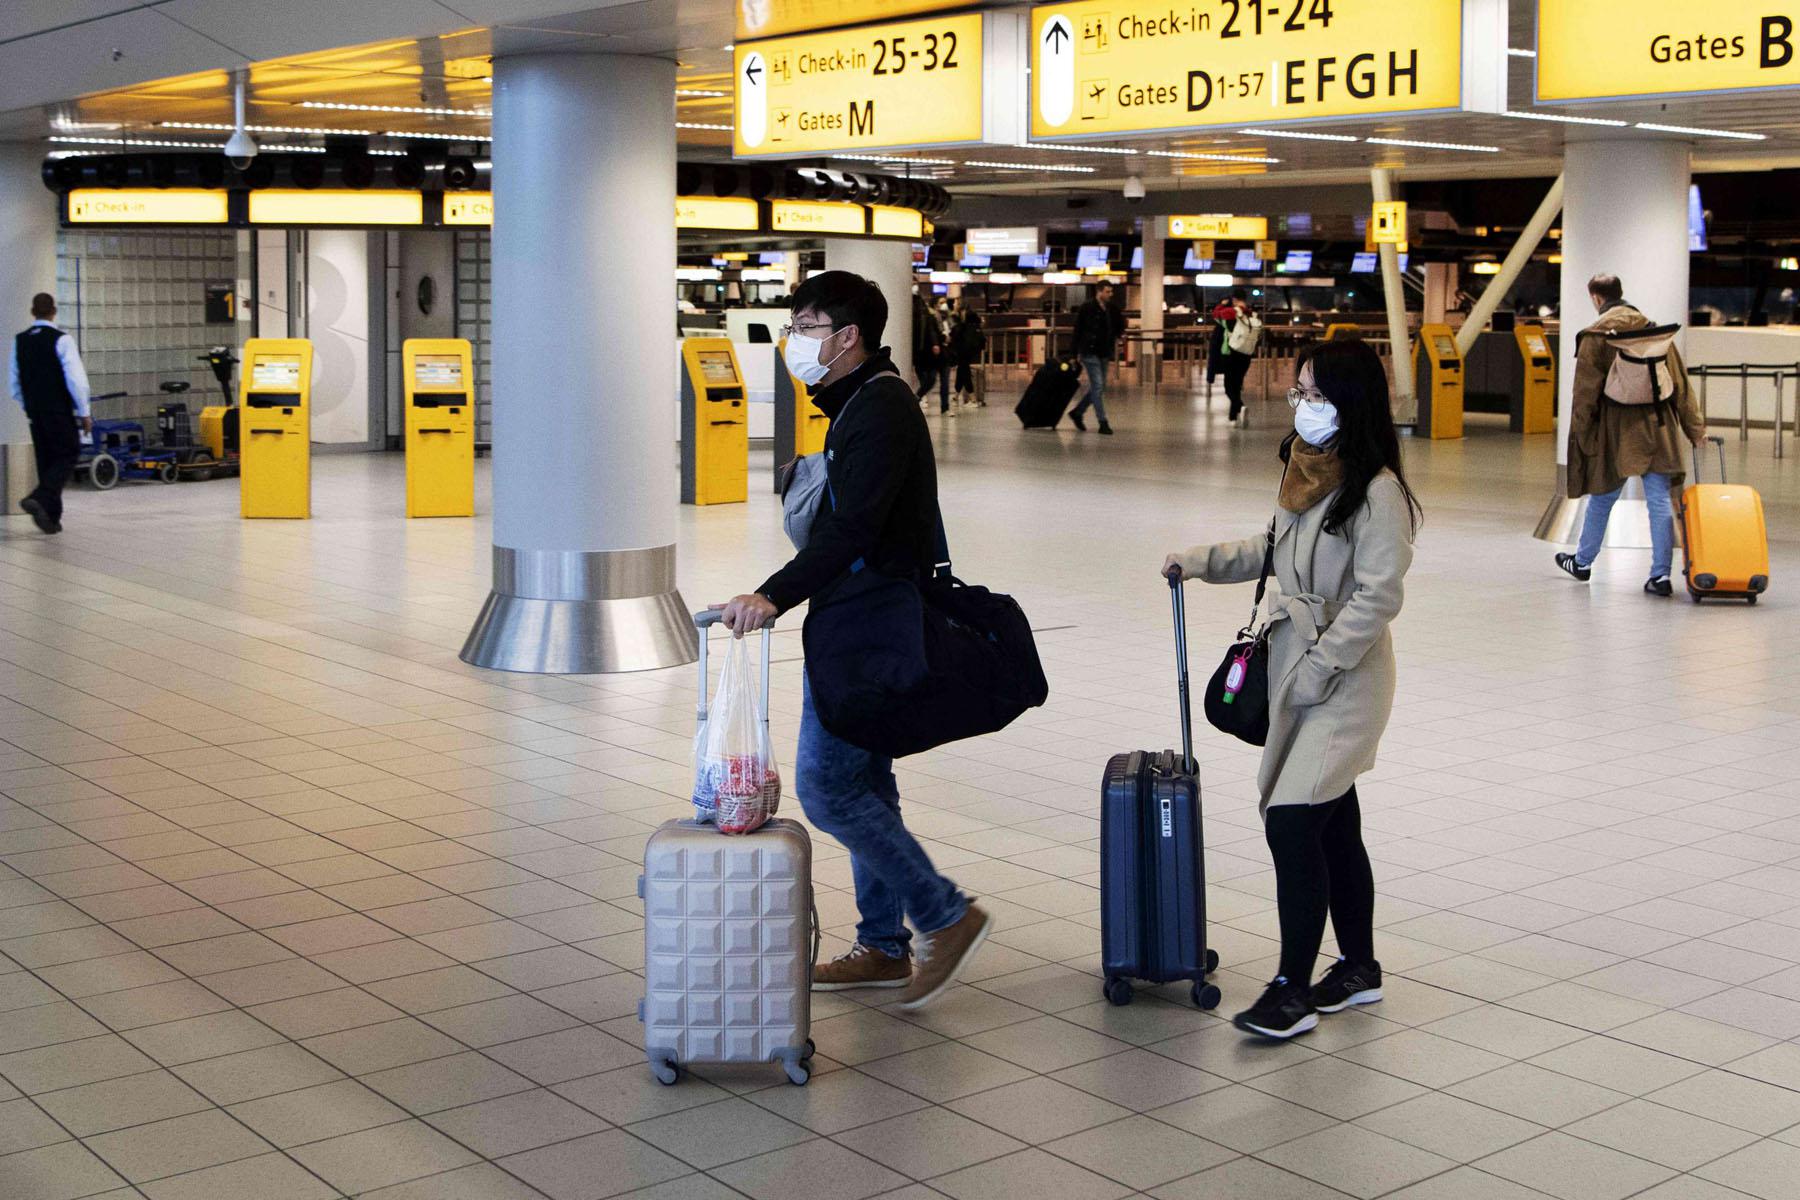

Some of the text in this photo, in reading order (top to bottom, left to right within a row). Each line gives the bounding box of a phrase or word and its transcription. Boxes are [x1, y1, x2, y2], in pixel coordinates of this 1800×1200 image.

[1118, 0, 1334, 40] Check-in 21-24
[798, 31, 959, 76] Check-in 25-32
[1650, 15, 1794, 69] Gates B
[1118, 84, 1178, 107] Gates
[798, 99, 874, 137] Gates M
[95, 201, 145, 213] Check-in
[1218, 221, 1229, 234] M
